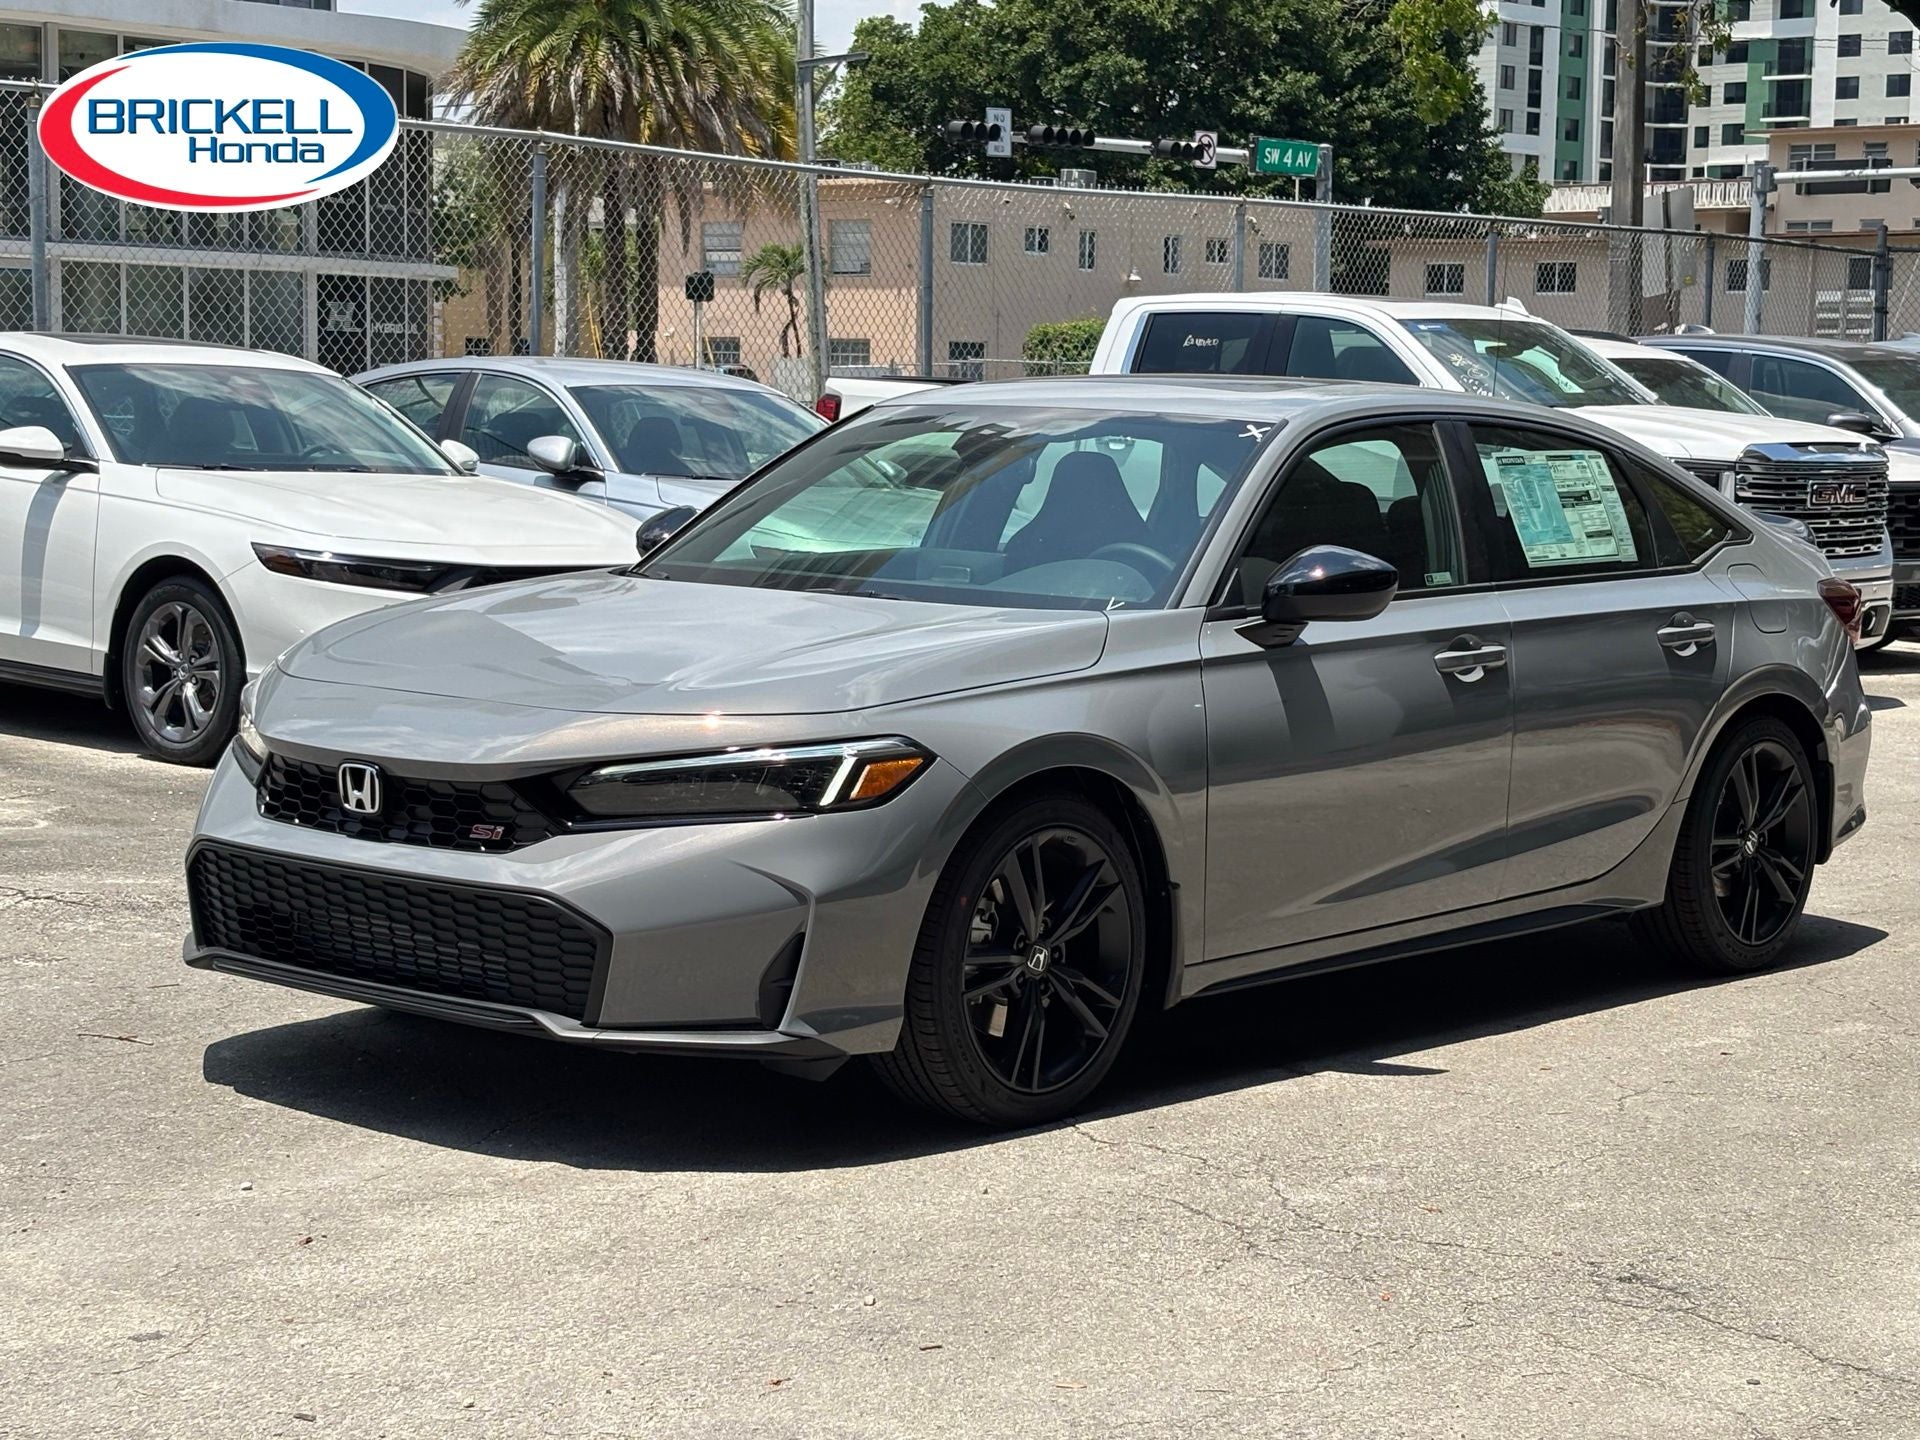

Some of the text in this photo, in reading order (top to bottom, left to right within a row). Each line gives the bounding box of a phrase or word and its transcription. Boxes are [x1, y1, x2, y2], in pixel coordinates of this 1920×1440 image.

[993, 113, 1006, 123] NO
[1264, 147, 1312, 168] SW 4 AV
[1812, 484, 1866, 504] GMC
[469, 824, 505, 839] Si
